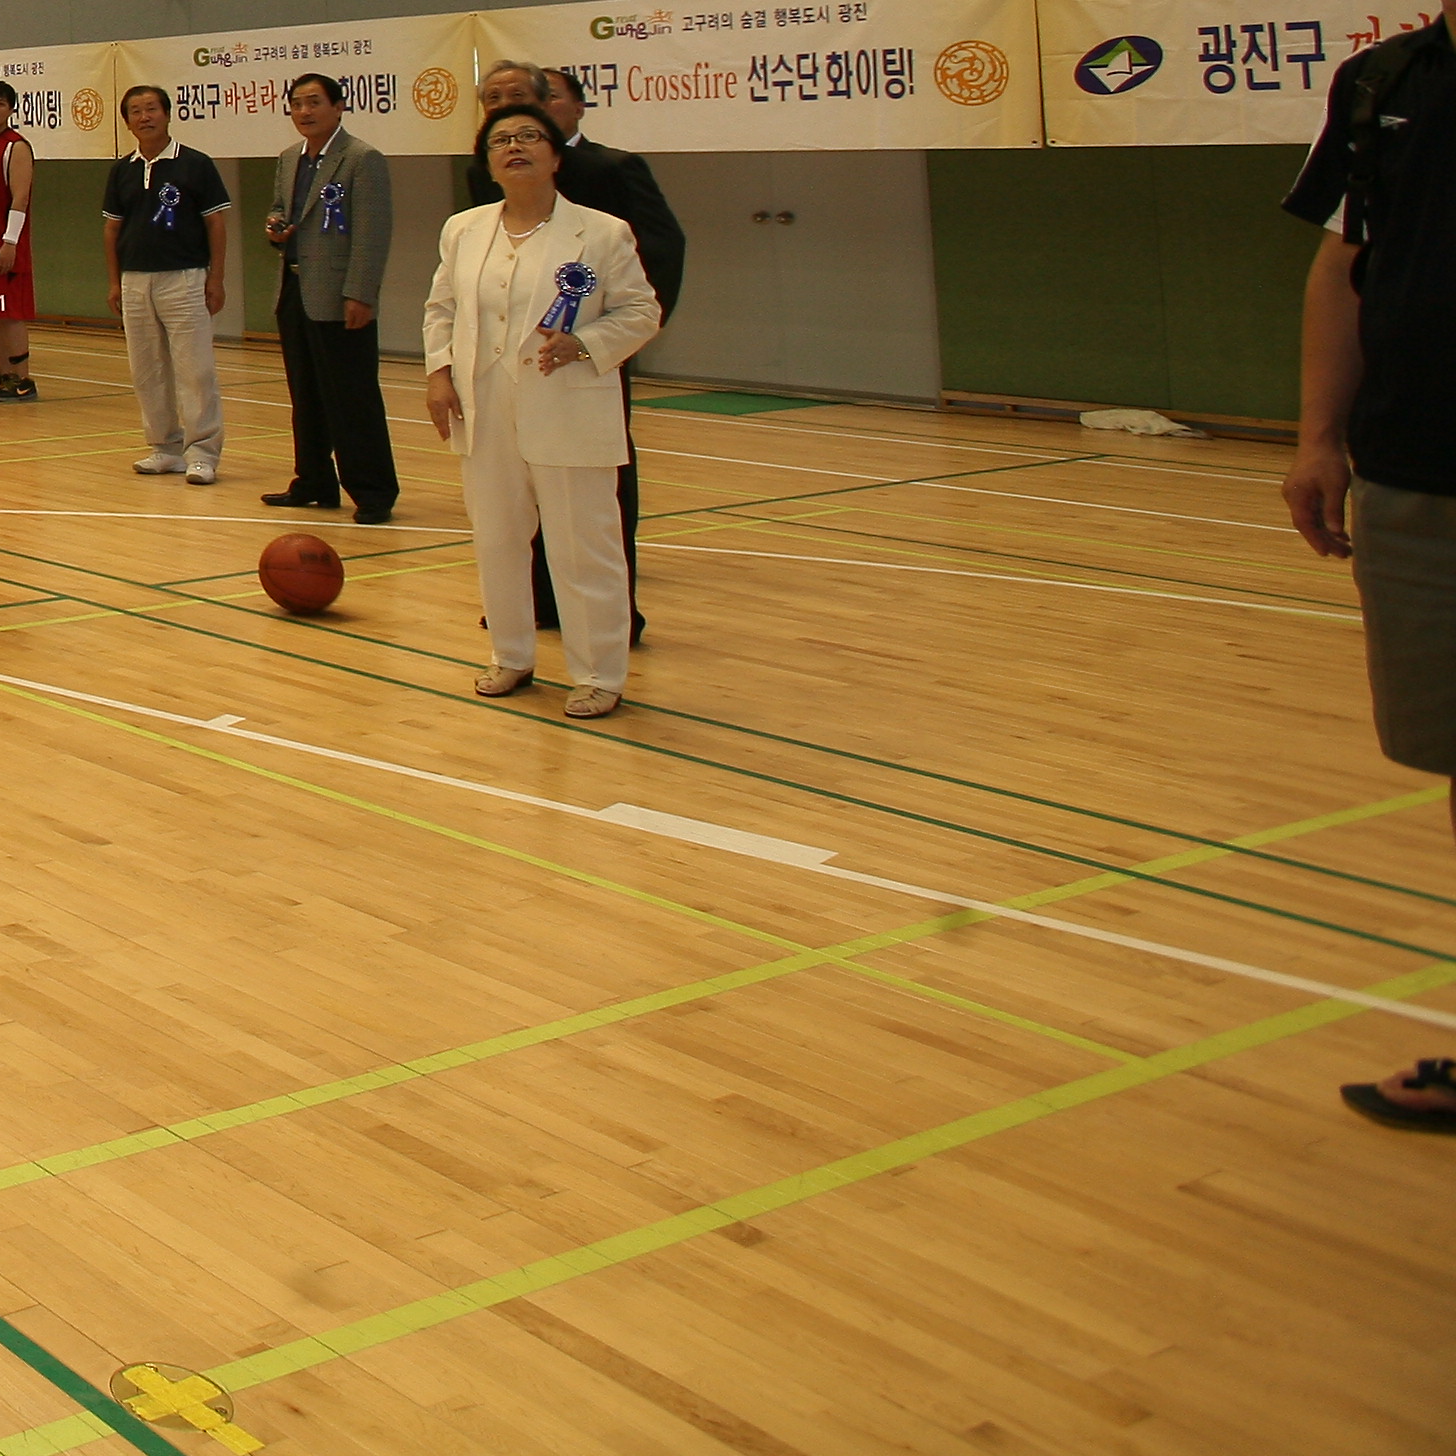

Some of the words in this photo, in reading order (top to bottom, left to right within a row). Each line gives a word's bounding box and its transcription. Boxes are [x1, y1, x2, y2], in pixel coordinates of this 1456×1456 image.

[681, 14, 734, 32] 고구려의
[740, 8, 767, 30] 숨결
[773, 5, 831, 28] 행복도시
[837, 1, 868, 24] 광진
[253, 46, 287, 62] 고구려의
[291, 44, 309, 60] 숨결
[313, 42, 349, 59] 행복도시
[353, 39, 373, 56] 광진
[1198, 21, 1326, 94] 광진구
[626, 60, 738, 102] Crossfire
[747, 51, 819, 103] 선수단
[825, 46, 916, 100] 화이팅!
[23, 91, 62, 129] 화이팅!
[176, 83, 220, 121] 광진구
[224, 80, 277, 116] 바닐라
